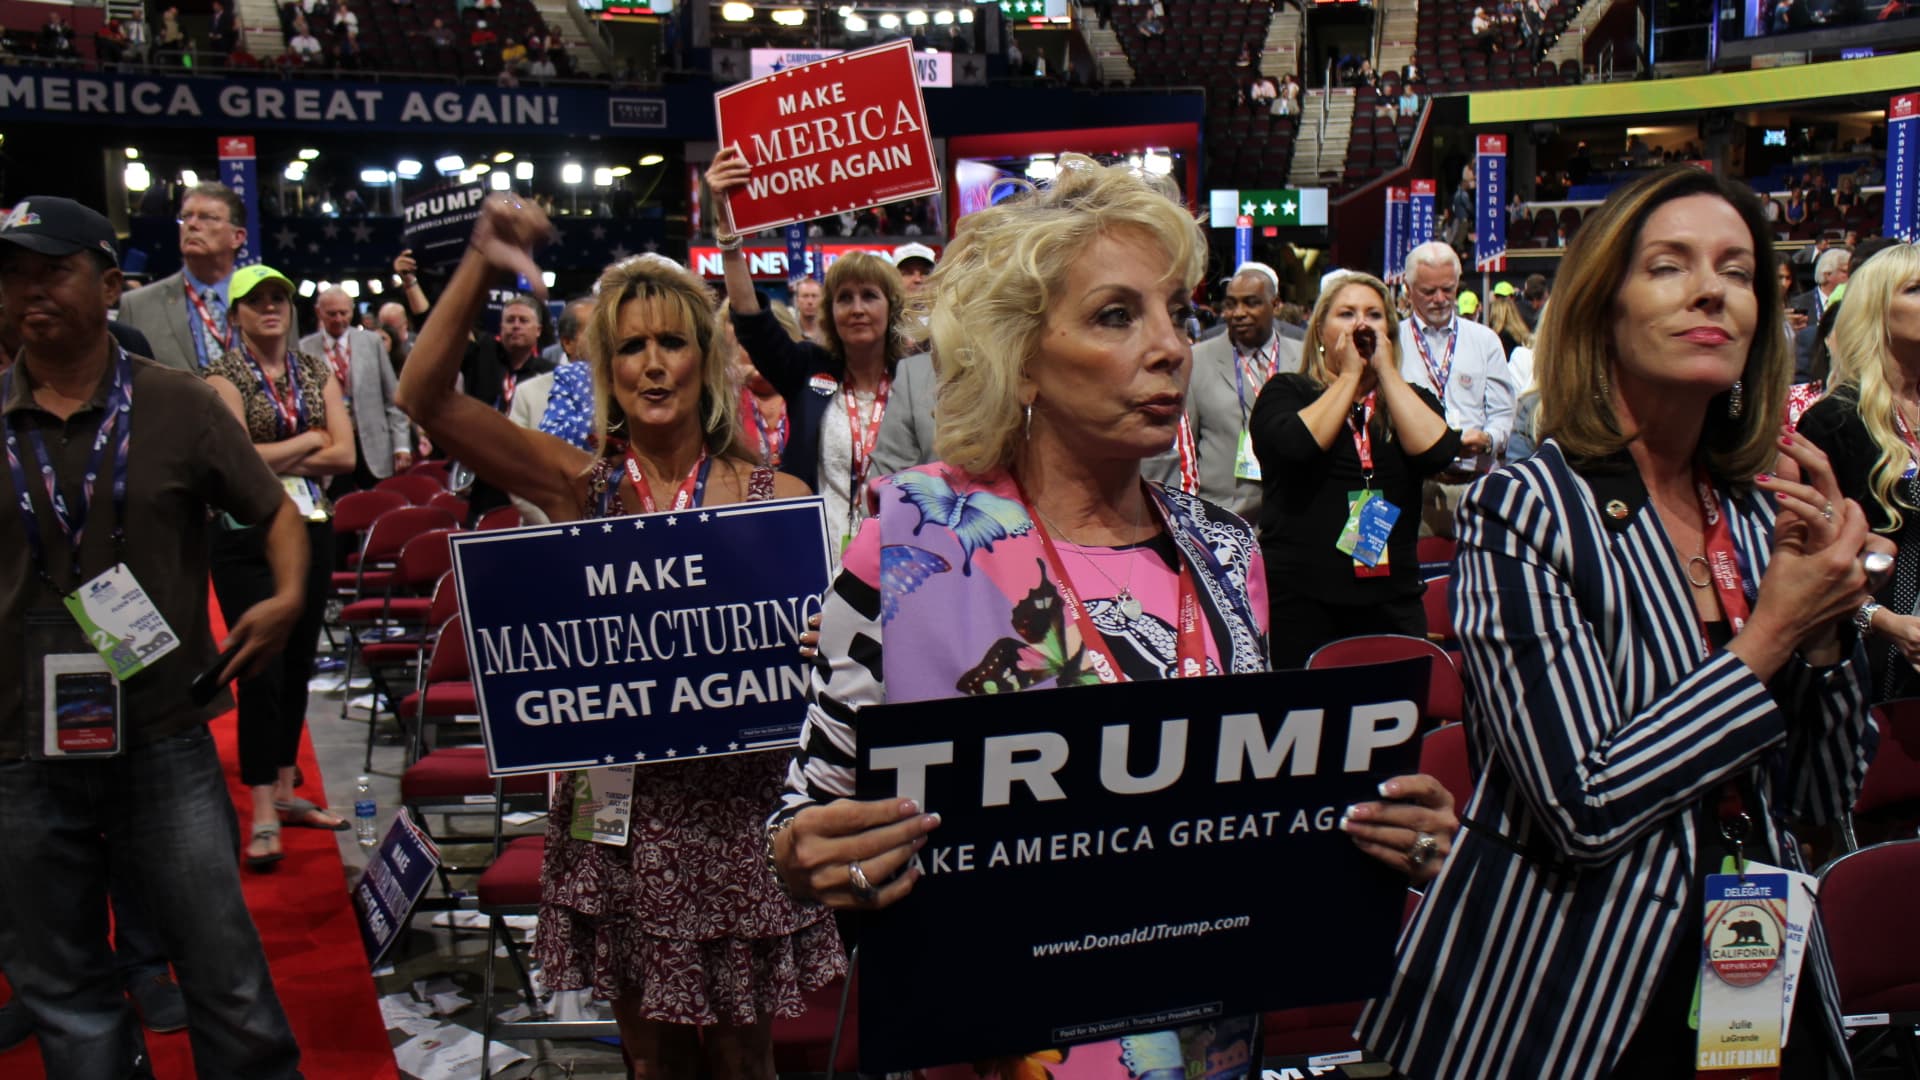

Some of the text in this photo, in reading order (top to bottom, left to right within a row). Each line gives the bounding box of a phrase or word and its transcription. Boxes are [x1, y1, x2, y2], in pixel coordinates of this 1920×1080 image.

[218, 86, 383, 121] GREAT
[400, 91, 560, 125] AGAIN!
[778, 82, 847, 116] MAKE
[746, 143, 914, 201] WORK AGAIN
[1894, 122, 1907, 230] MASSACHUSETTS
[404, 188, 484, 223] TRUMP
[1488, 159, 1498, 242] GEORGIA
[1412, 197, 1421, 247] AMERIC
[1423, 205, 1433, 238] SAMO
[585, 554, 707, 597] MAKE
[515, 662, 811, 727] GREAT AGAIN
[869, 699, 1420, 814] TRUMP
[907, 844, 976, 876] AKE
[986, 826, 1156, 869] AMERICA
[1169, 809, 1282, 847] GREAT
[1724, 887, 1772, 898] DELEGATE
[1032, 915, 1251, 957] www.DonaldJTrump.com
[1712, 948, 1777, 959] CALIFORNIA
[1099, 1021, 1125, 1032] Donald
[1132, 1017, 1156, 1027] Trump
[1720, 1033, 1760, 1043] LaGrande
[1729, 1020, 1753, 1030] Julie
[1700, 1048, 1777, 1067] CALIFORNIA
